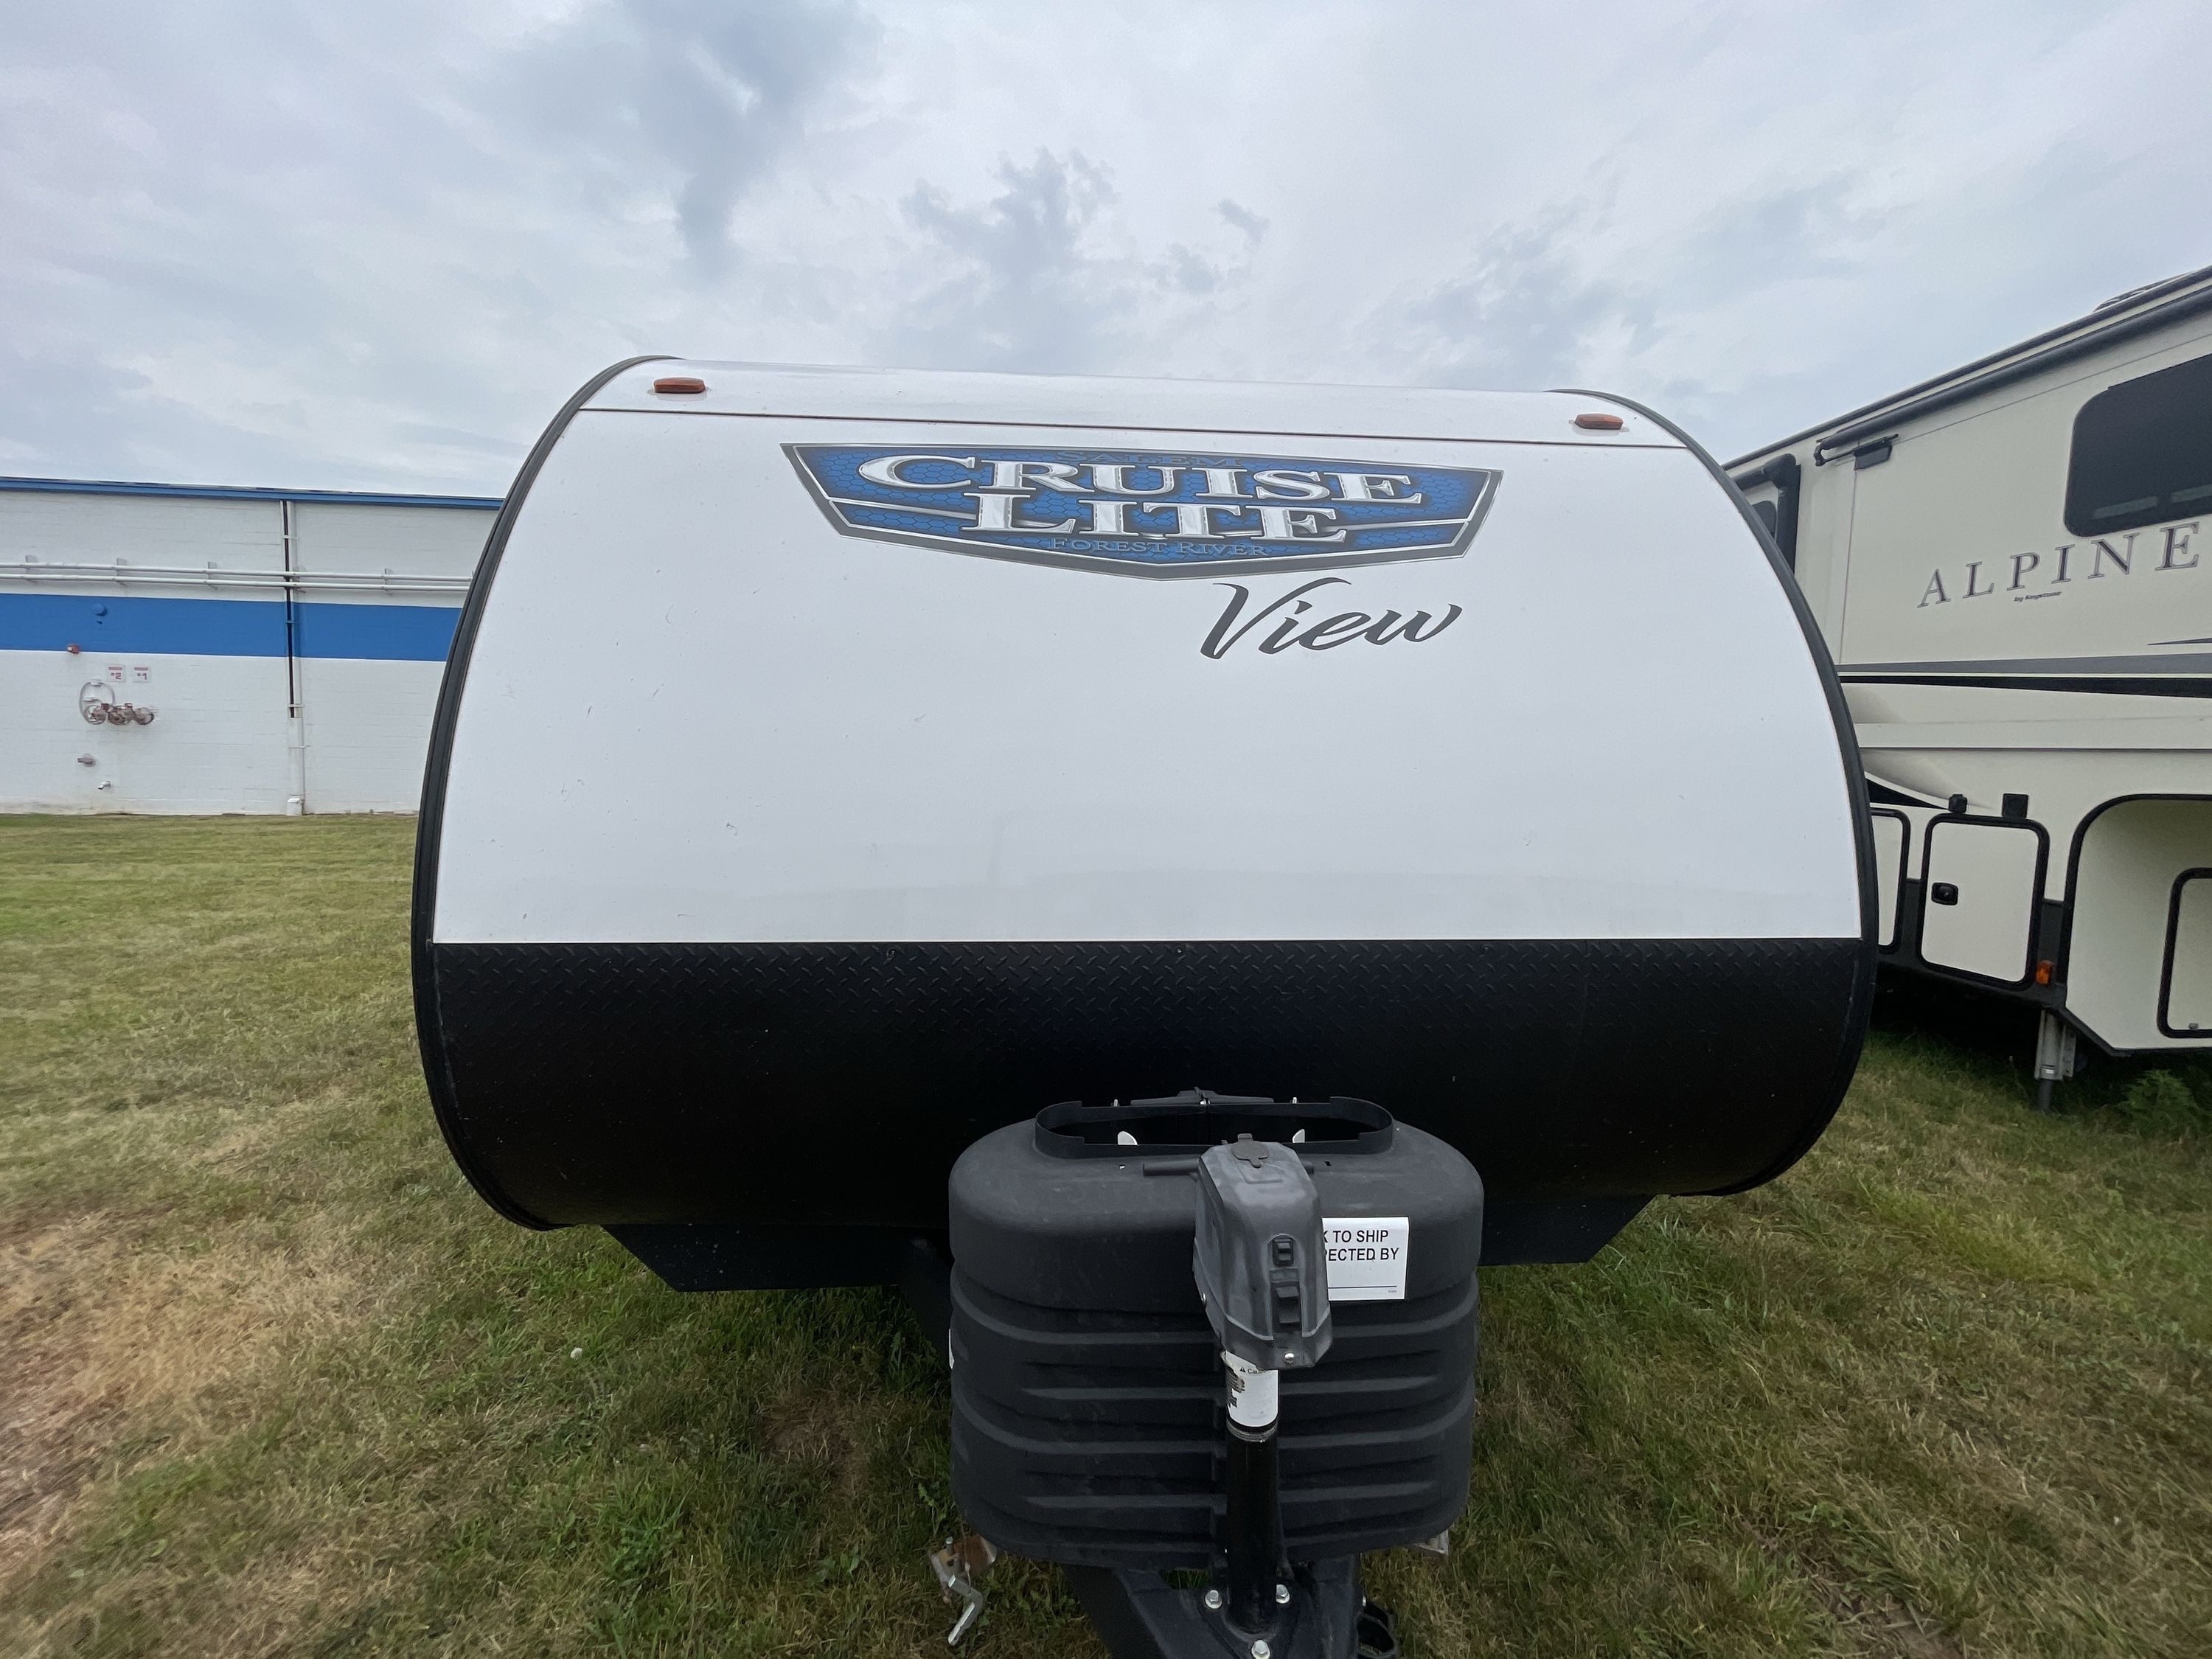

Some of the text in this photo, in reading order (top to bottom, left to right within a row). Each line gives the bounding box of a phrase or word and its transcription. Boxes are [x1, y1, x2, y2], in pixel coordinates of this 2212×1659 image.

[1056, 451, 1242, 467] SALEM
[858, 454, 1422, 504] CRUISE
[961, 492, 1347, 543] LITE
[1047, 537, 1269, 556] FOREST RIVER
[1917, 521, 2200, 608] ALPINE
[1200, 577, 1463, 660] View
[1332, 1230, 1352, 1243] TO
[1357, 1229, 1389, 1243] SHIP
[1325, 1247, 1399, 1262] ECTED BY
